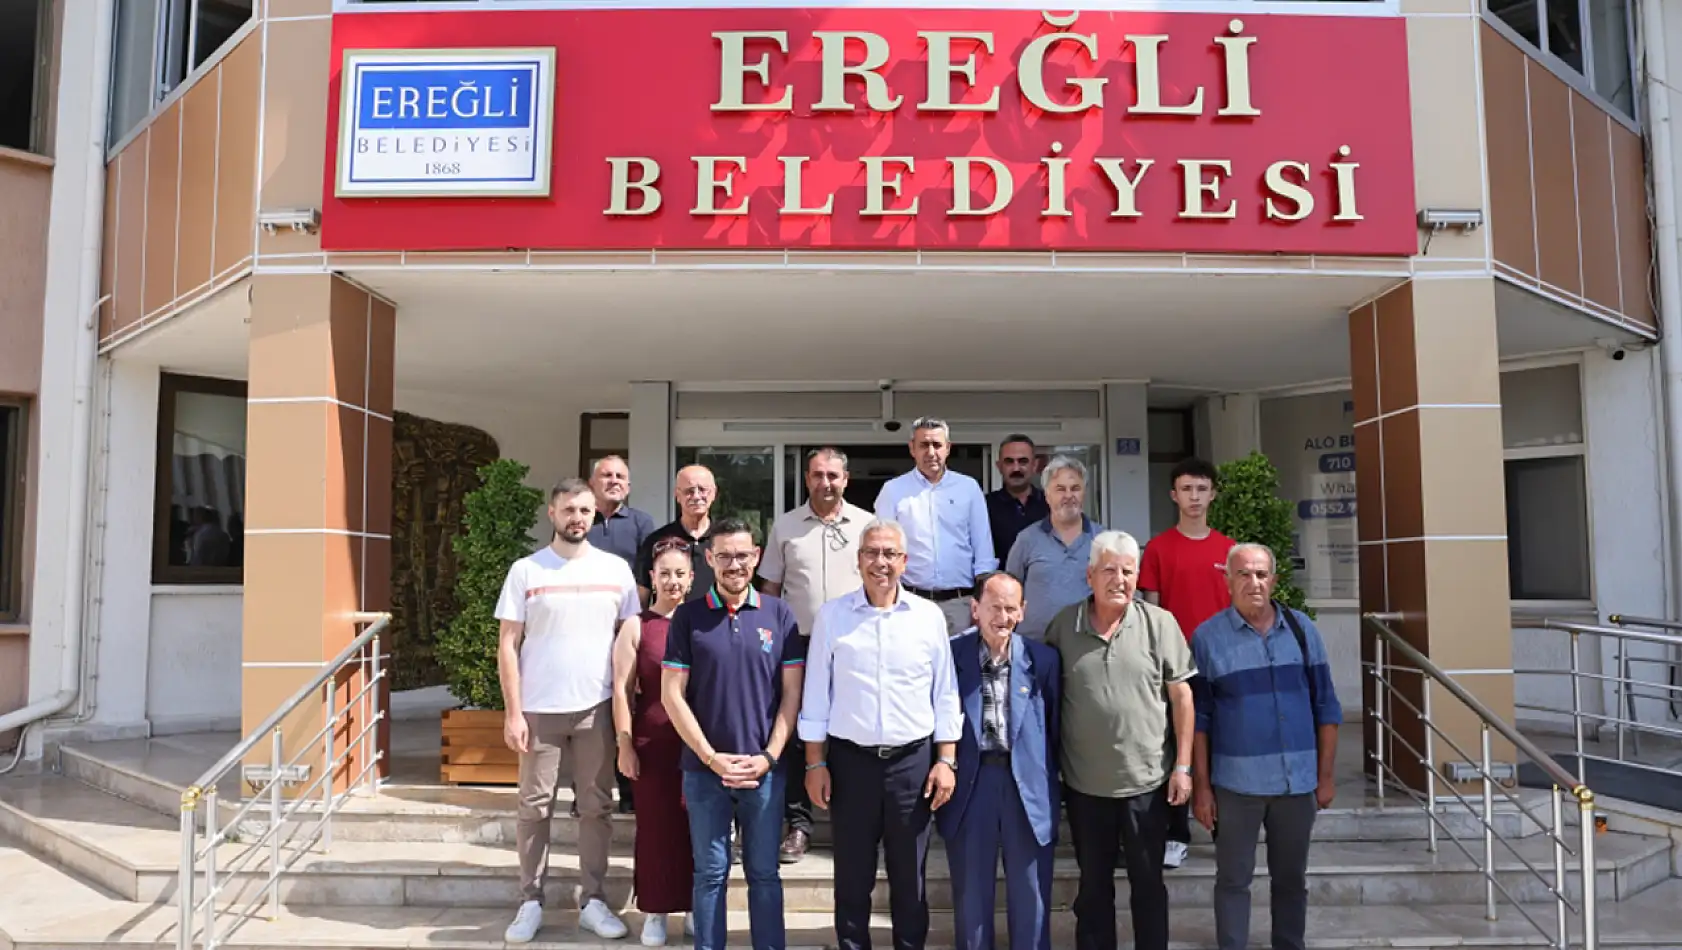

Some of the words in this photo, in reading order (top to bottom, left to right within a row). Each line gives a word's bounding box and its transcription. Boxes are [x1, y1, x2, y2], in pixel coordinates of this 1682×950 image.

[711, 10, 1262, 117] EREĞLİ
[371, 77, 519, 119] EREĞLİ
[425, 162, 461, 175] 1868
[603, 142, 1365, 222] BELEDİYESİ
[1304, 436, 1335, 450] ALO
[1327, 456, 1351, 469] 710
[1310, 502, 1345, 515] 0552
